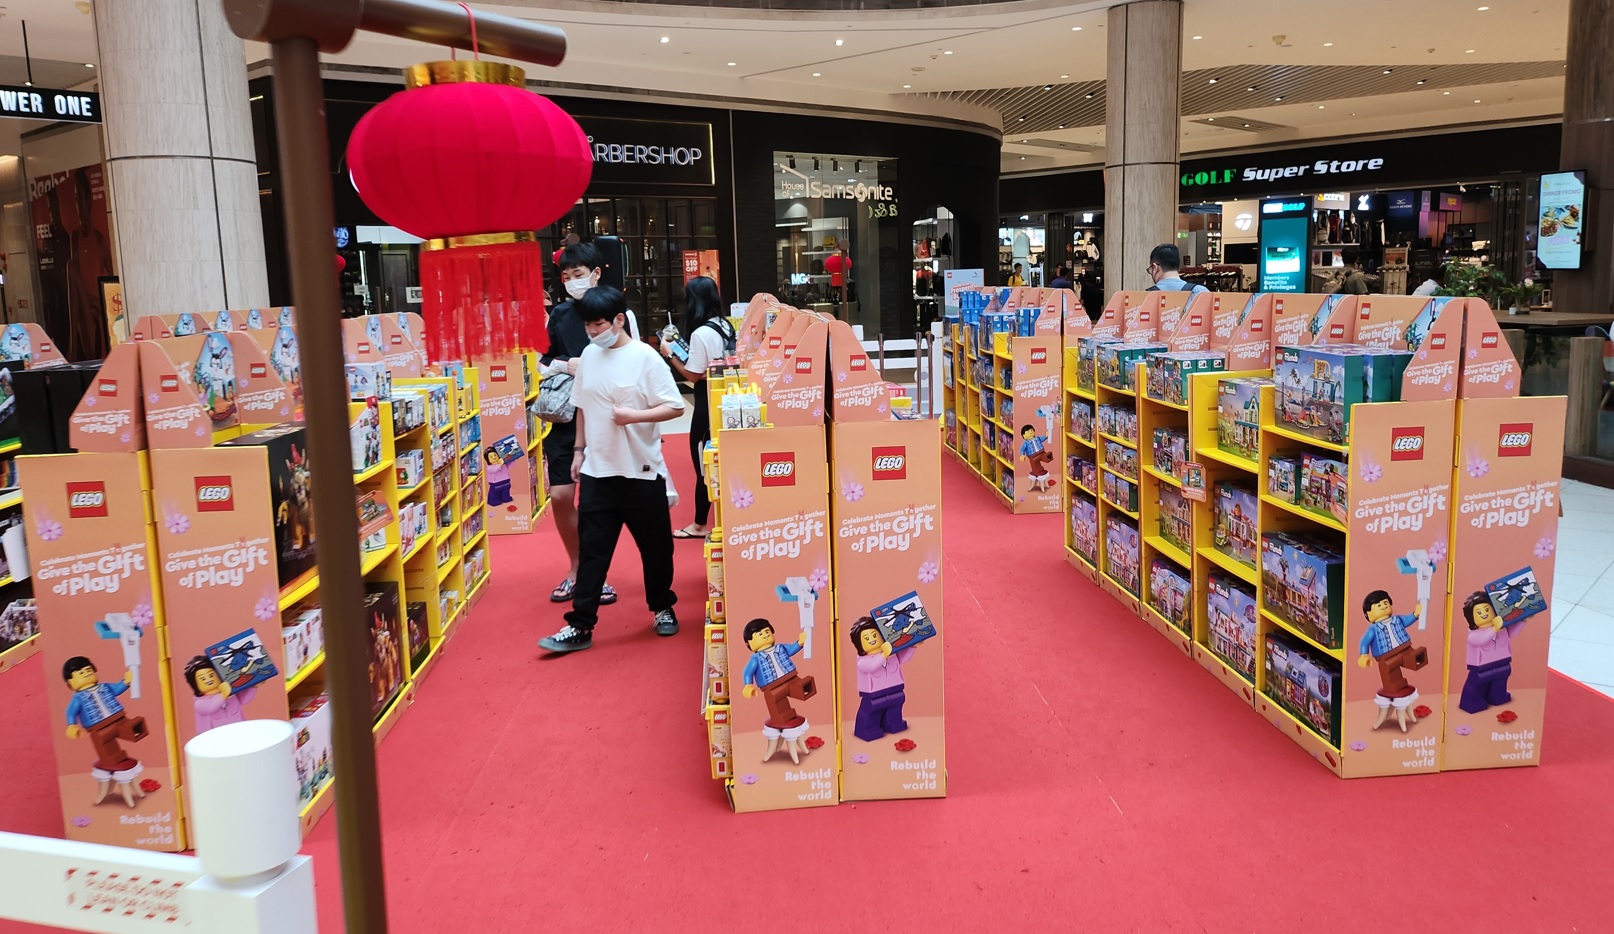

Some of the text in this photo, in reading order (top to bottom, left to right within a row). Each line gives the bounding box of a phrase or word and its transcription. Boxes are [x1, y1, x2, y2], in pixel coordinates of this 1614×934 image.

[54, 94, 93, 117] ONE
[589, 143, 702, 166] RBERSHOP
[1180, 157, 1384, 187] GOLF Super Store
[781, 180, 804, 191] House
[782, 189, 790, 198] of
[1407, 369, 1421, 377] Give
[1421, 367, 1433, 375] the
[1432, 364, 1453, 377] Gift
[1464, 368, 1479, 376] Give
[1490, 363, 1513, 376] Gift
[1039, 378, 1059, 391] Gift
[1411, 374, 1440, 385] of Play
[1468, 373, 1500, 384] of Play
[771, 389, 822, 402] Give the Gift
[834, 387, 885, 400] Give the Gift
[1021, 388, 1048, 398] of Play
[501, 396, 522, 409] Gift
[777, 399, 809, 409] of Play
[840, 396, 872, 407] of Play
[482, 406, 510, 416] of Play
[1393, 436, 1423, 450] LEGO
[1501, 433, 1531, 447] LEGO
[763, 461, 794, 477] LEGO
[874, 456, 904, 470] LEGO
[199, 486, 231, 501] LEGO
[1358, 484, 1449, 506] Celebrate Moments Together
[1464, 481, 1558, 501] Celebrate Moments Together
[71, 492, 104, 507] LEGO
[1355, 492, 1446, 519] Give the Gift
[1460, 489, 1554, 514] Give the Gift
[842, 503, 937, 525] Celebrate Moments Together
[1471, 509, 1530, 529] of Play
[731, 509, 826, 533] Celebrate Moments Together
[839, 512, 933, 538] Give the Gift
[1365, 512, 1423, 533] of Play
[728, 519, 824, 546] Give the Gift
[851, 532, 910, 553] of Play
[741, 539, 801, 560] of Play
[37, 552, 145, 580] Give the Gift
[165, 557, 195, 573] Give
[197, 553, 222, 567] the
[223, 546, 268, 572] Gift
[52, 573, 120, 596] of Play
[178, 567, 244, 589] of Play
[1491, 729, 1535, 742] Rebuild
[1392, 736, 1436, 749] Rebuild
[1514, 740, 1534, 749] the
[1415, 748, 1435, 757] the
[1501, 750, 1533, 760] world
[890, 759, 937, 771] Rebuild
[1402, 757, 1435, 768] world
[785, 768, 831, 782] Rebuild
[916, 770, 937, 780] the
[811, 780, 831, 790] the
[902, 780, 937, 790] world
[797, 790, 832, 801] world
[119, 812, 171, 825] Rebuild
[148, 824, 172, 834] the
[135, 834, 173, 845] world
